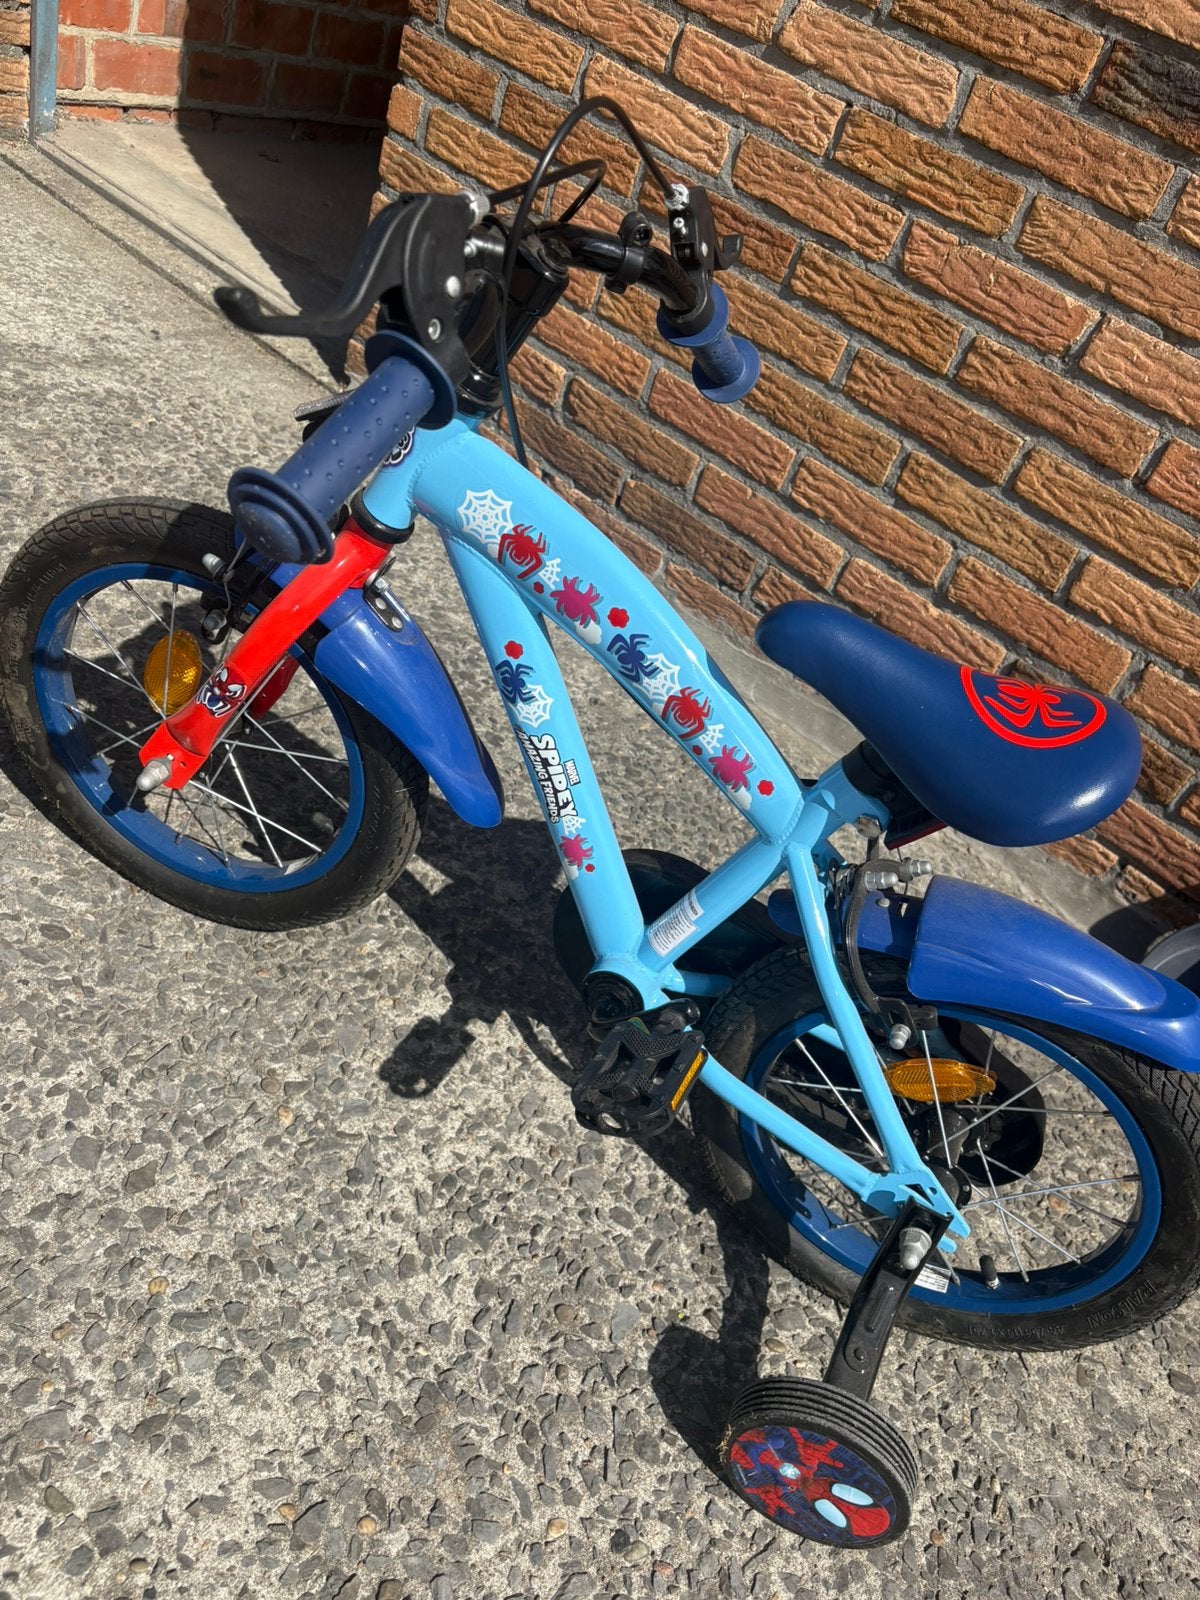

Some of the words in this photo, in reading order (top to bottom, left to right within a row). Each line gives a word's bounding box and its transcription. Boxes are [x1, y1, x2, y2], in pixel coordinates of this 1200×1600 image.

[516, 729, 548, 780] AMAZING
[541, 780, 560, 823] FRIENDS
[529, 733, 578, 817] SPIDEY
[564, 759, 580, 786] MARVEL
